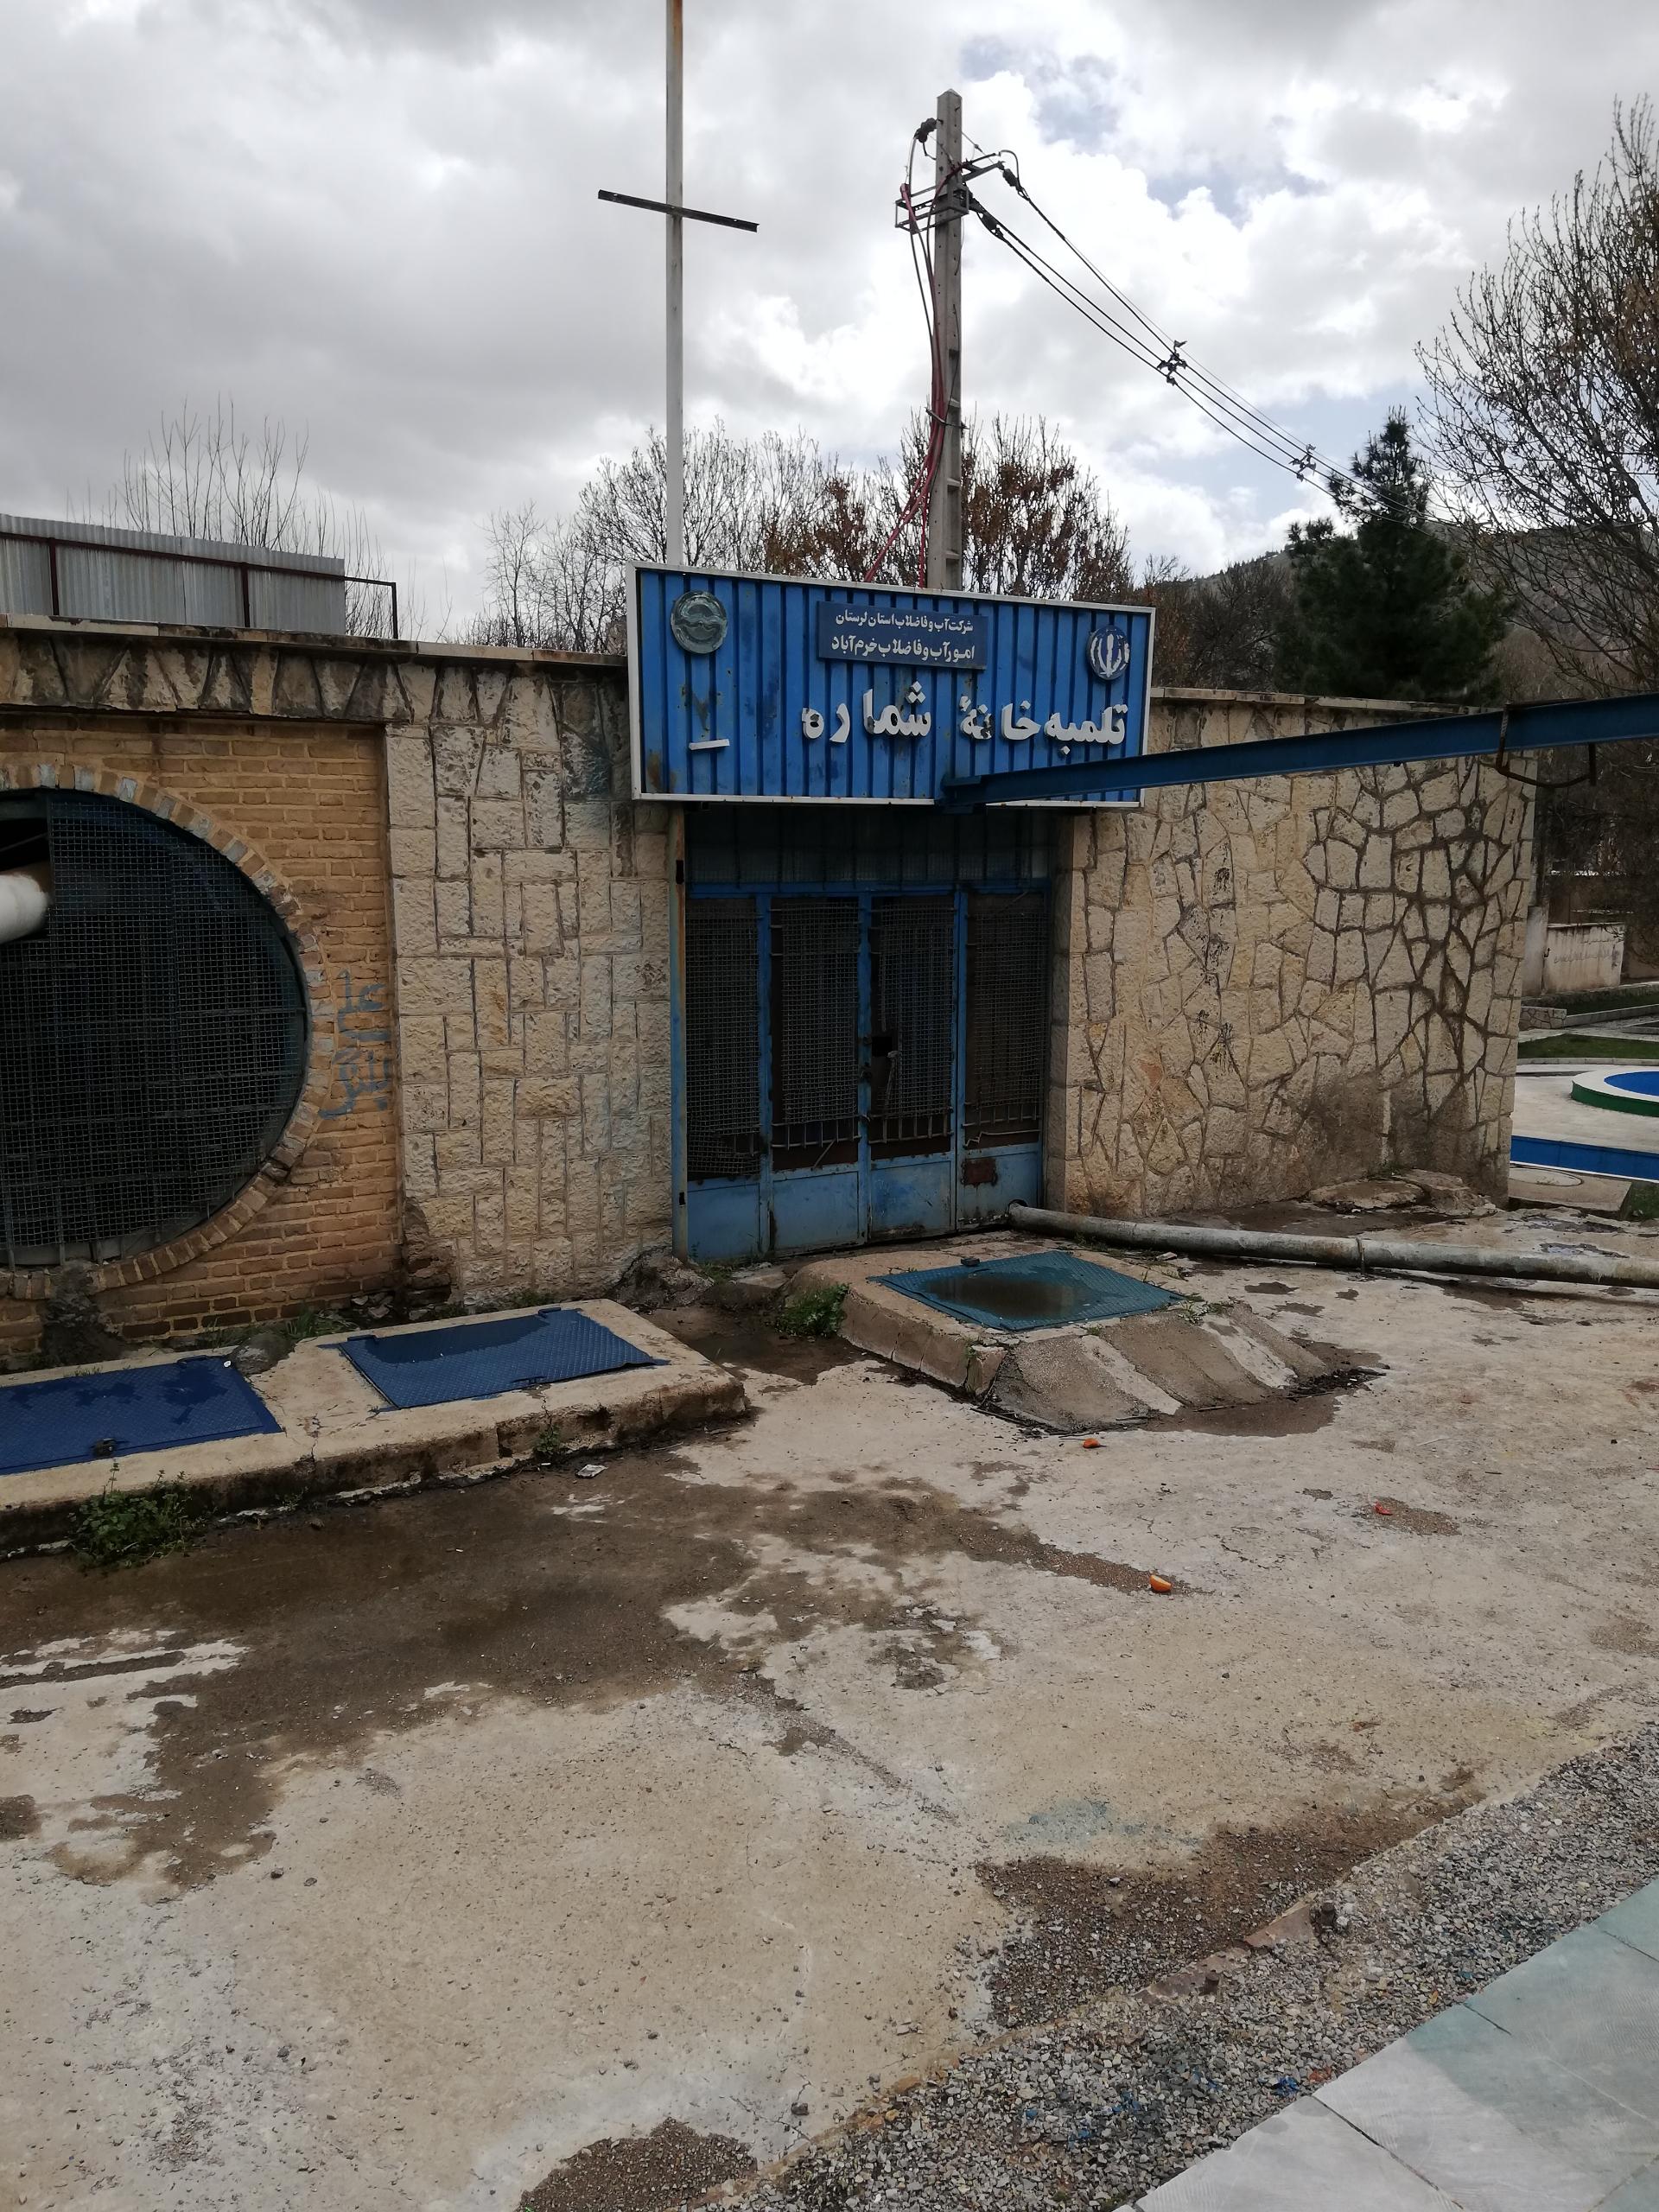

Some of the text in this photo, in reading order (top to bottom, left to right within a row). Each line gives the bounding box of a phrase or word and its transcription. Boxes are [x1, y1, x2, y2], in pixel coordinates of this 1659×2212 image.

[836, 609, 868, 626] لرستان
[868, 613, 895, 627] استان
[895, 614, 928, 630] فاضلاب
[934, 618, 949, 632] آب
[949, 620, 974, 634] شرکت
[878, 639, 923, 658] فاضلاب
[930, 641, 950, 661] آب
[946, 645, 975, 663] امور
[801, 681, 931, 743] شماره
[1044, 703, 1128, 755] تلمبه
